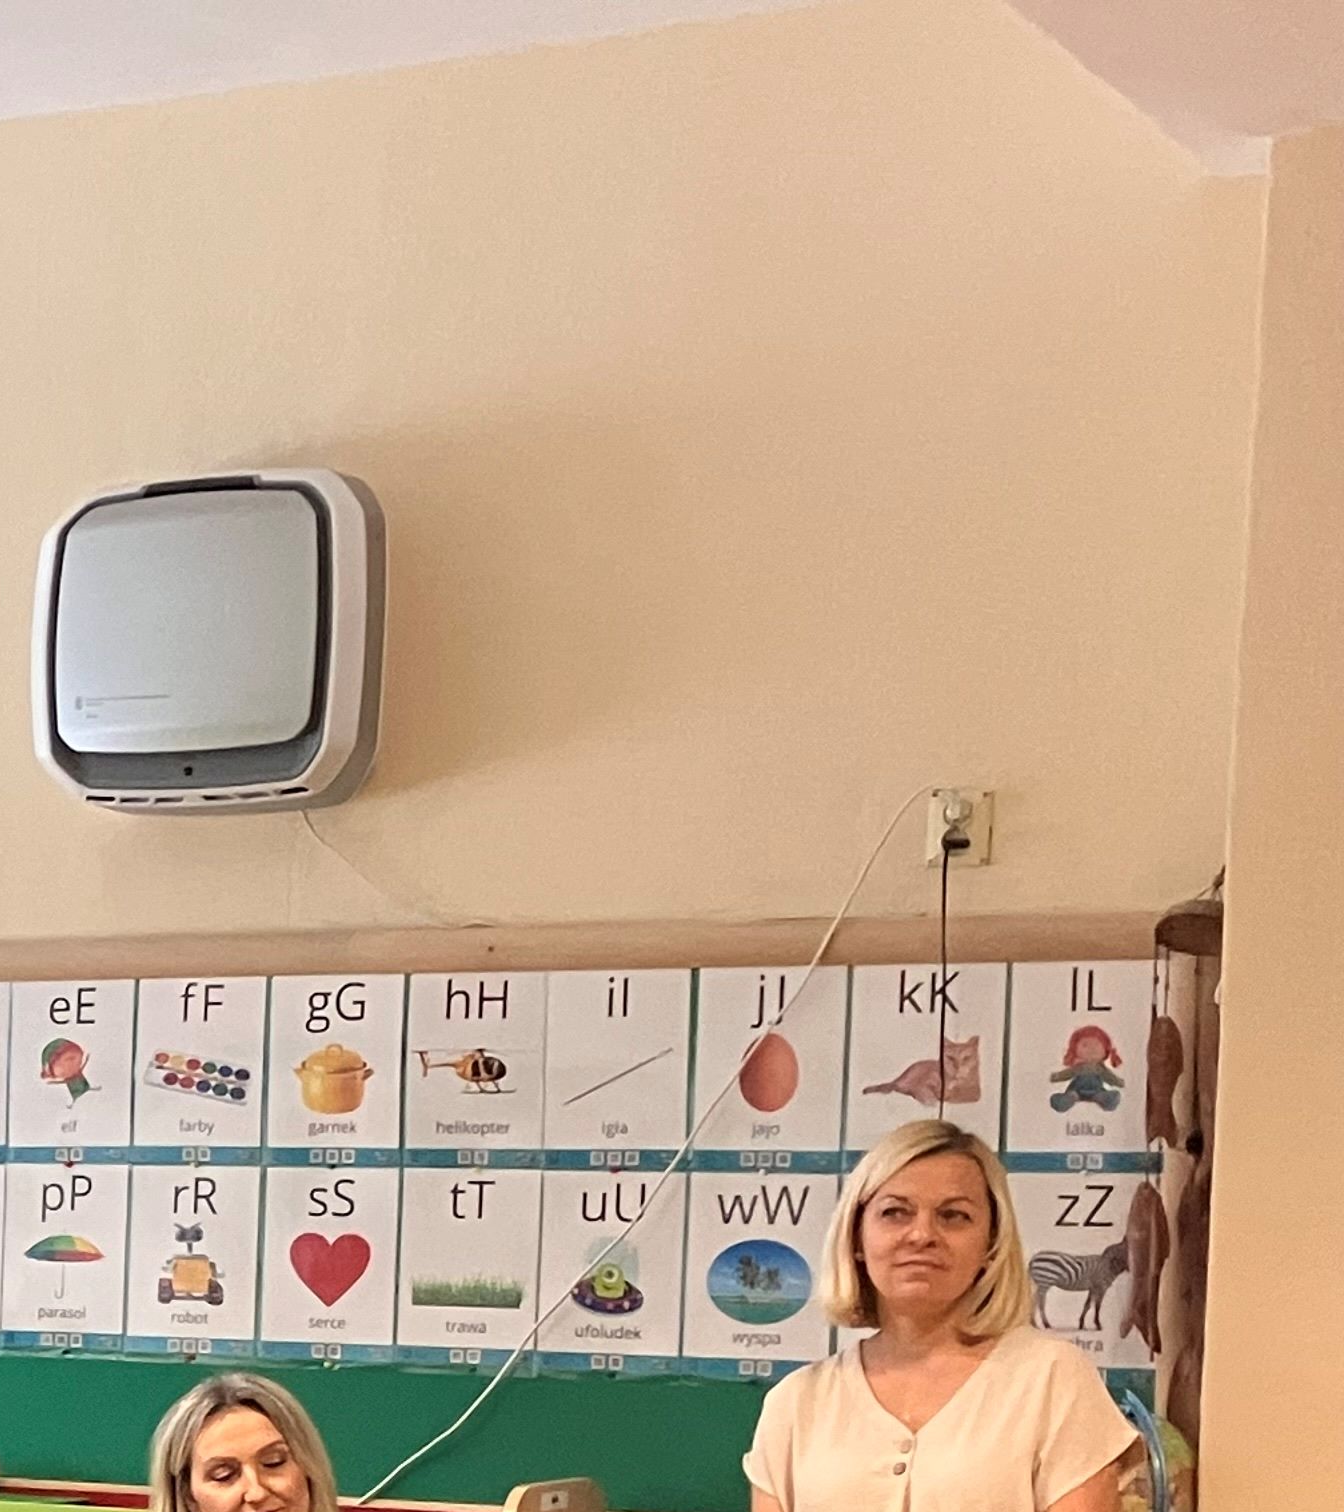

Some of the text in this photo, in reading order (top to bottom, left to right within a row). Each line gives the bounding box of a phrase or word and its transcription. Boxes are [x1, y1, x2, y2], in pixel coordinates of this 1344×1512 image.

[50, 988, 96, 1024] eE
[181, 983, 224, 1022] fF
[306, 983, 365, 1033] gG
[446, 979, 508, 1019] hH
[750, 975, 786, 1029] jJ
[899, 969, 959, 1015] kK
[180, 1119, 214, 1136] farby
[308, 1121, 356, 1136] garnek
[436, 1121, 510, 1136] helikopter
[1066, 1122, 1104, 1136] lalka
[42, 1175, 92, 1222] pP
[174, 1177, 217, 1214] rR
[309, 1179, 355, 1217] sS
[451, 1181, 495, 1219] tT
[582, 1183, 646, 1222] uU
[718, 1185, 809, 1226] wW
[1055, 1185, 1114, 1227] zZ
[38, 1307, 86, 1320] parasol
[171, 1312, 208, 1324] robot
[309, 1318, 346, 1329] serce
[446, 1321, 486, 1333] trawa
[575, 1324, 641, 1339] ufoludek
[732, 1334, 781, 1349] wyspa
